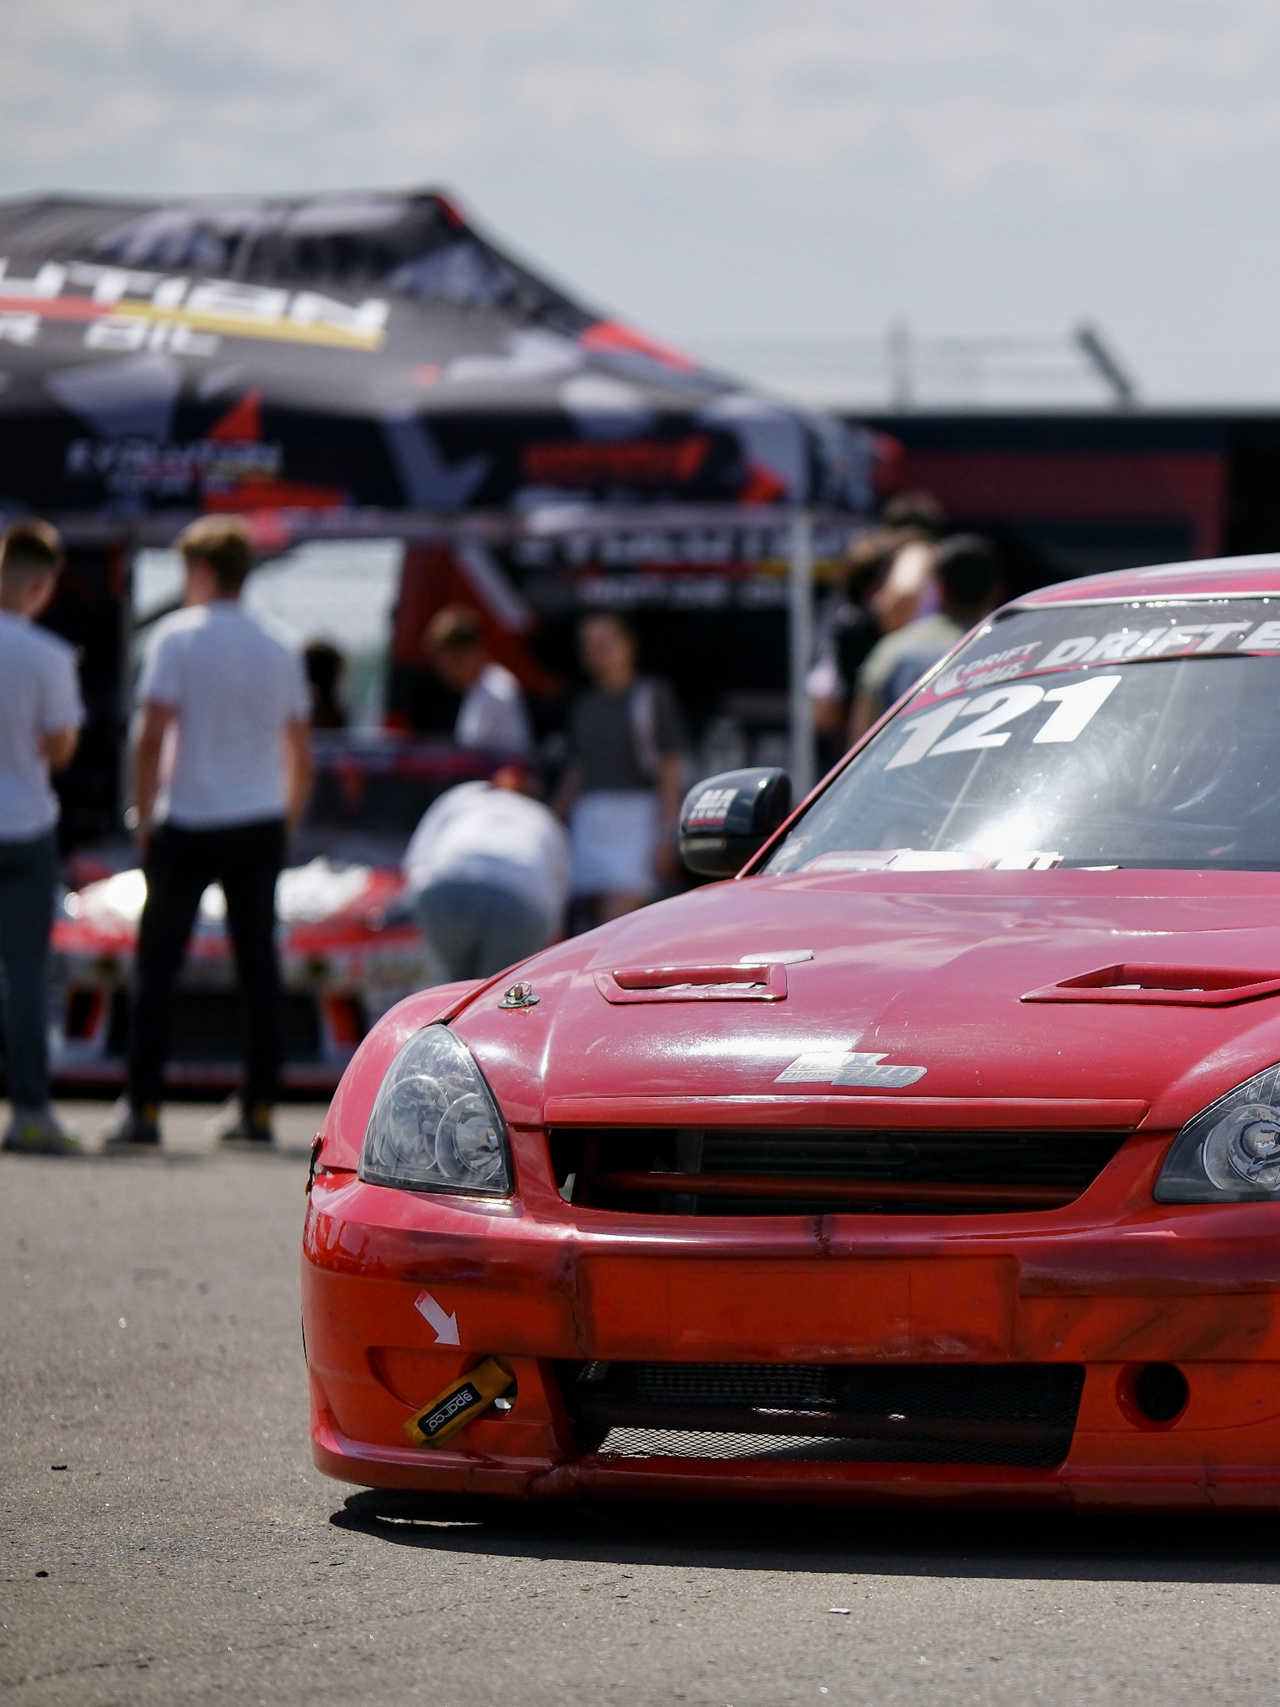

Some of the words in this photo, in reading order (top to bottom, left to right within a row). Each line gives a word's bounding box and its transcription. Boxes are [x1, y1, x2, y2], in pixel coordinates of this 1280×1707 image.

[83, 317, 221, 358] OIL
[964, 641, 1042, 674] DRIFT
[1034, 621, 1253, 669] DRIFT
[883, 675, 1122, 771] 121
[427, 1391, 473, 1430] sparco
